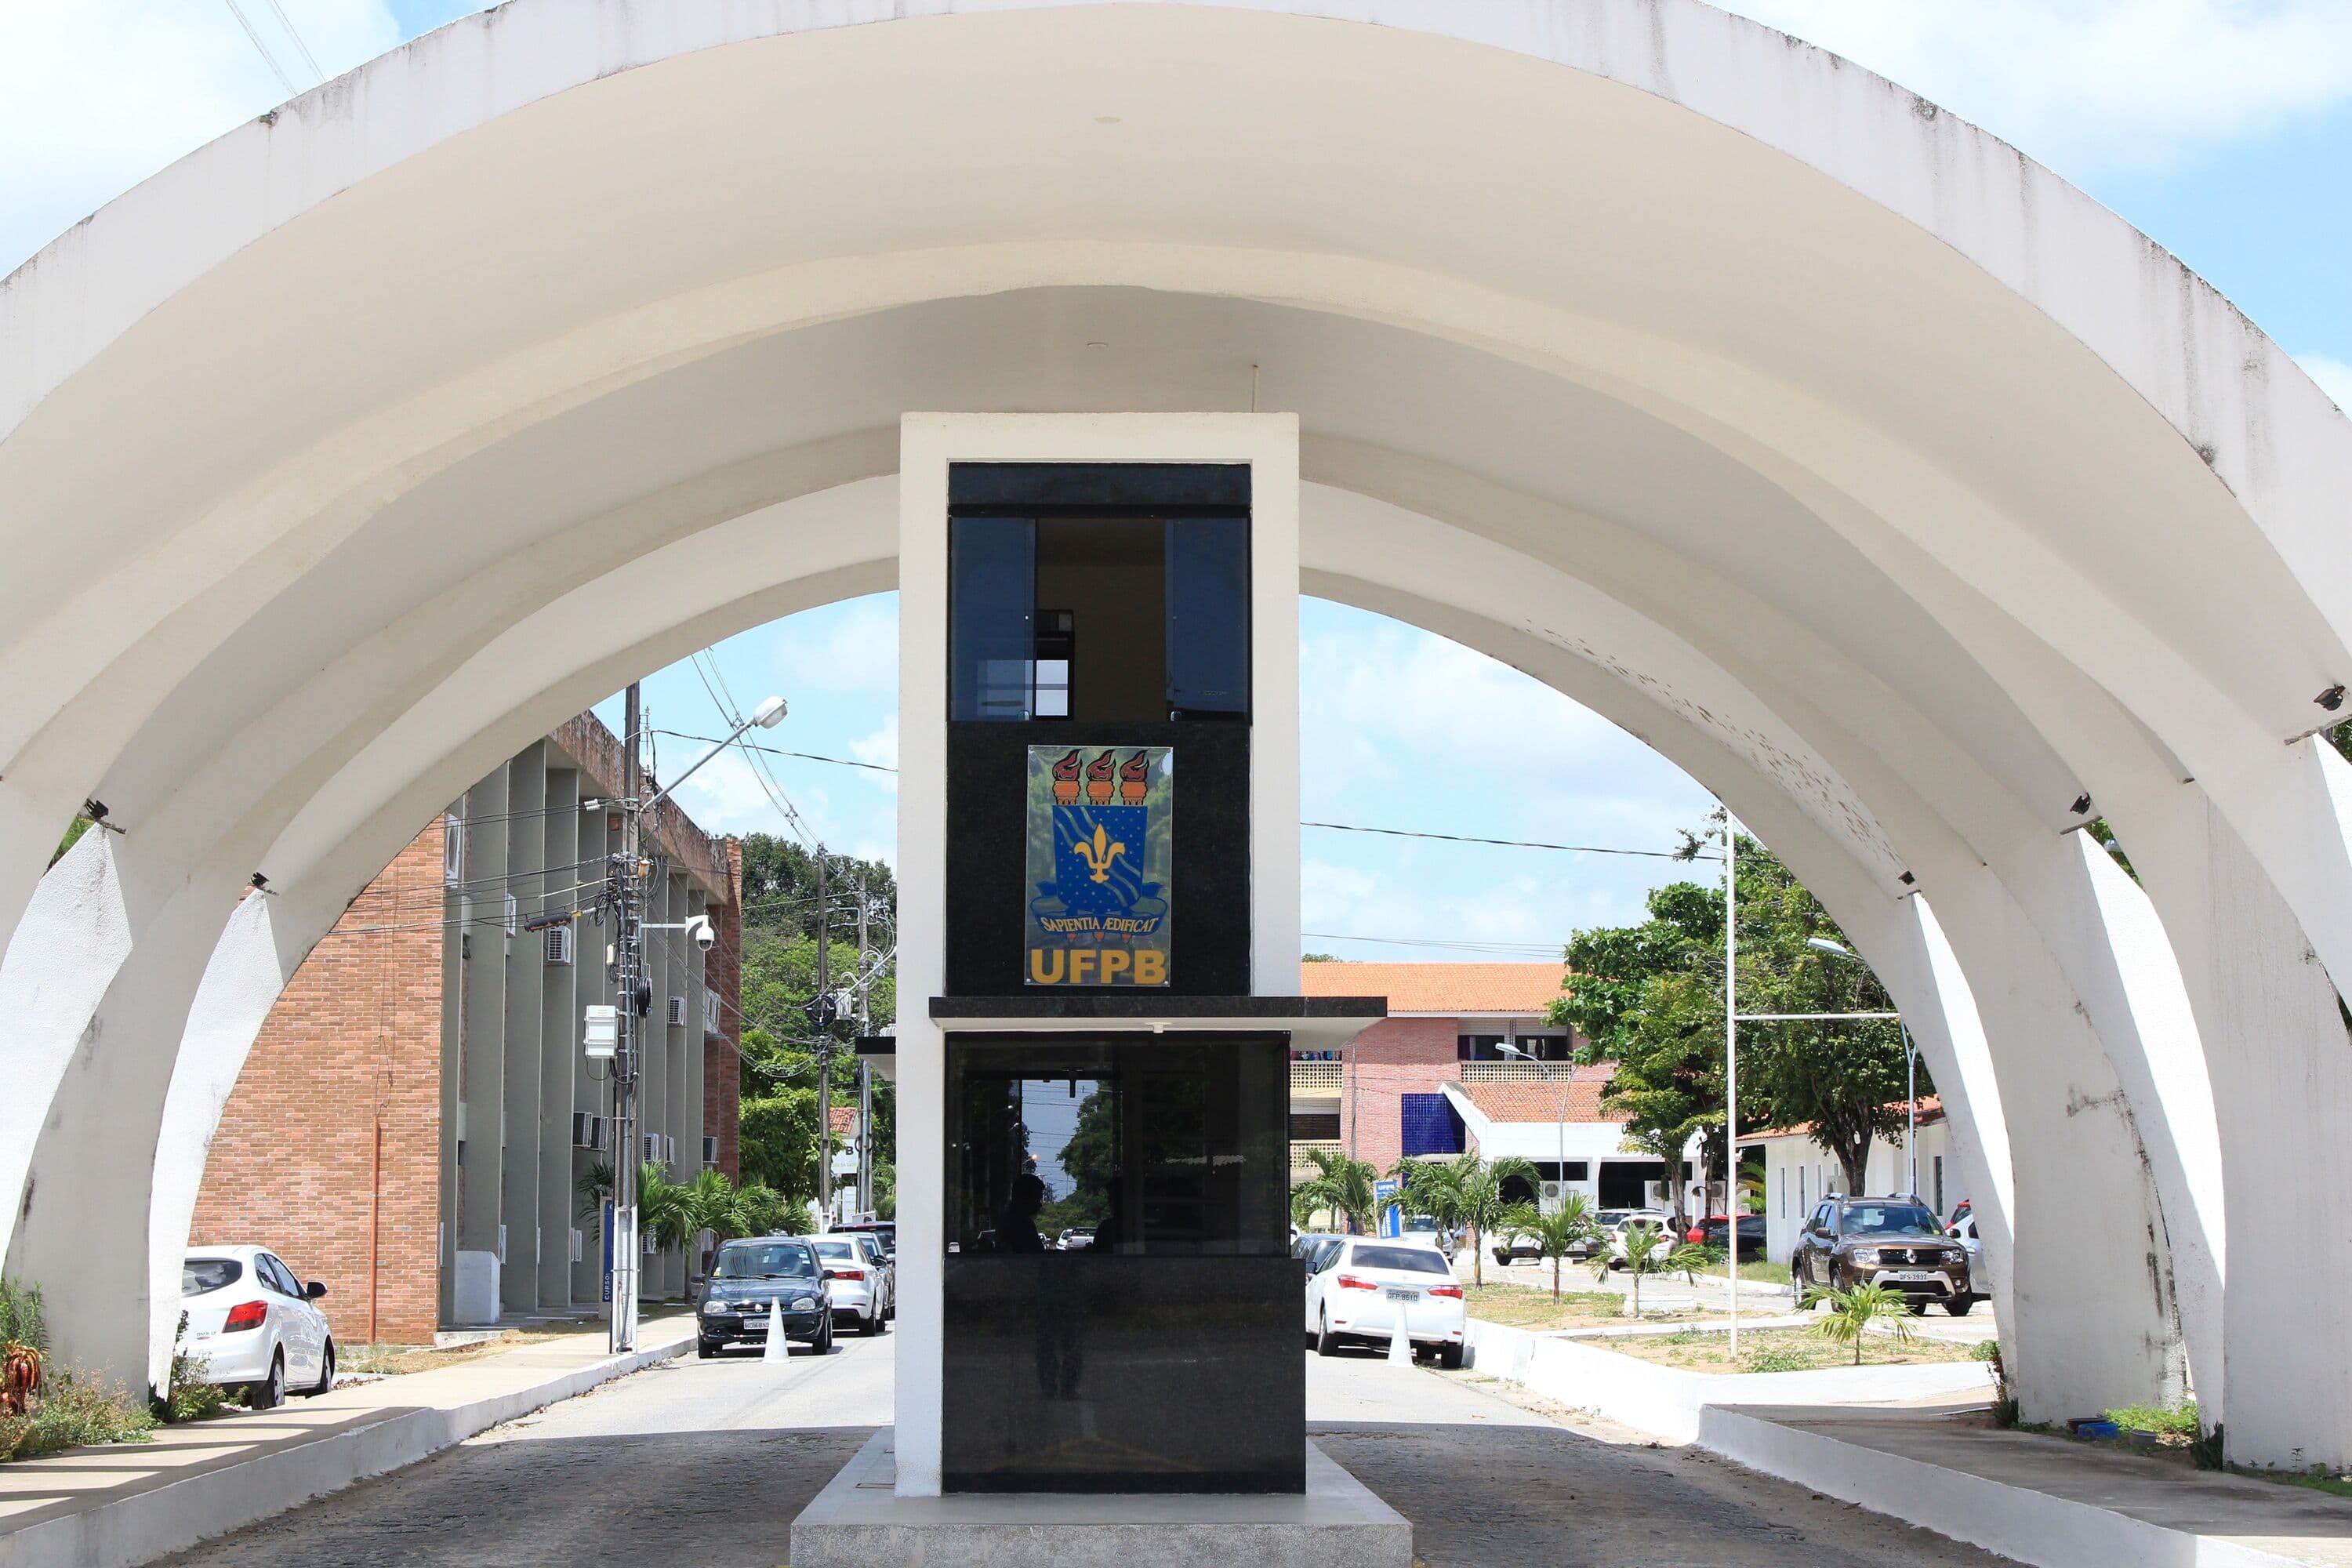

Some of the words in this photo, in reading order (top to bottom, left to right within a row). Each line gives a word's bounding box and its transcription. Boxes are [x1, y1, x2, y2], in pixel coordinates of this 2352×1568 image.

[1040, 916, 1101, 932] SAPIENTIA
[1102, 917, 1159, 933] ÆDIFICAT
[1031, 949, 1167, 985] UFPB
